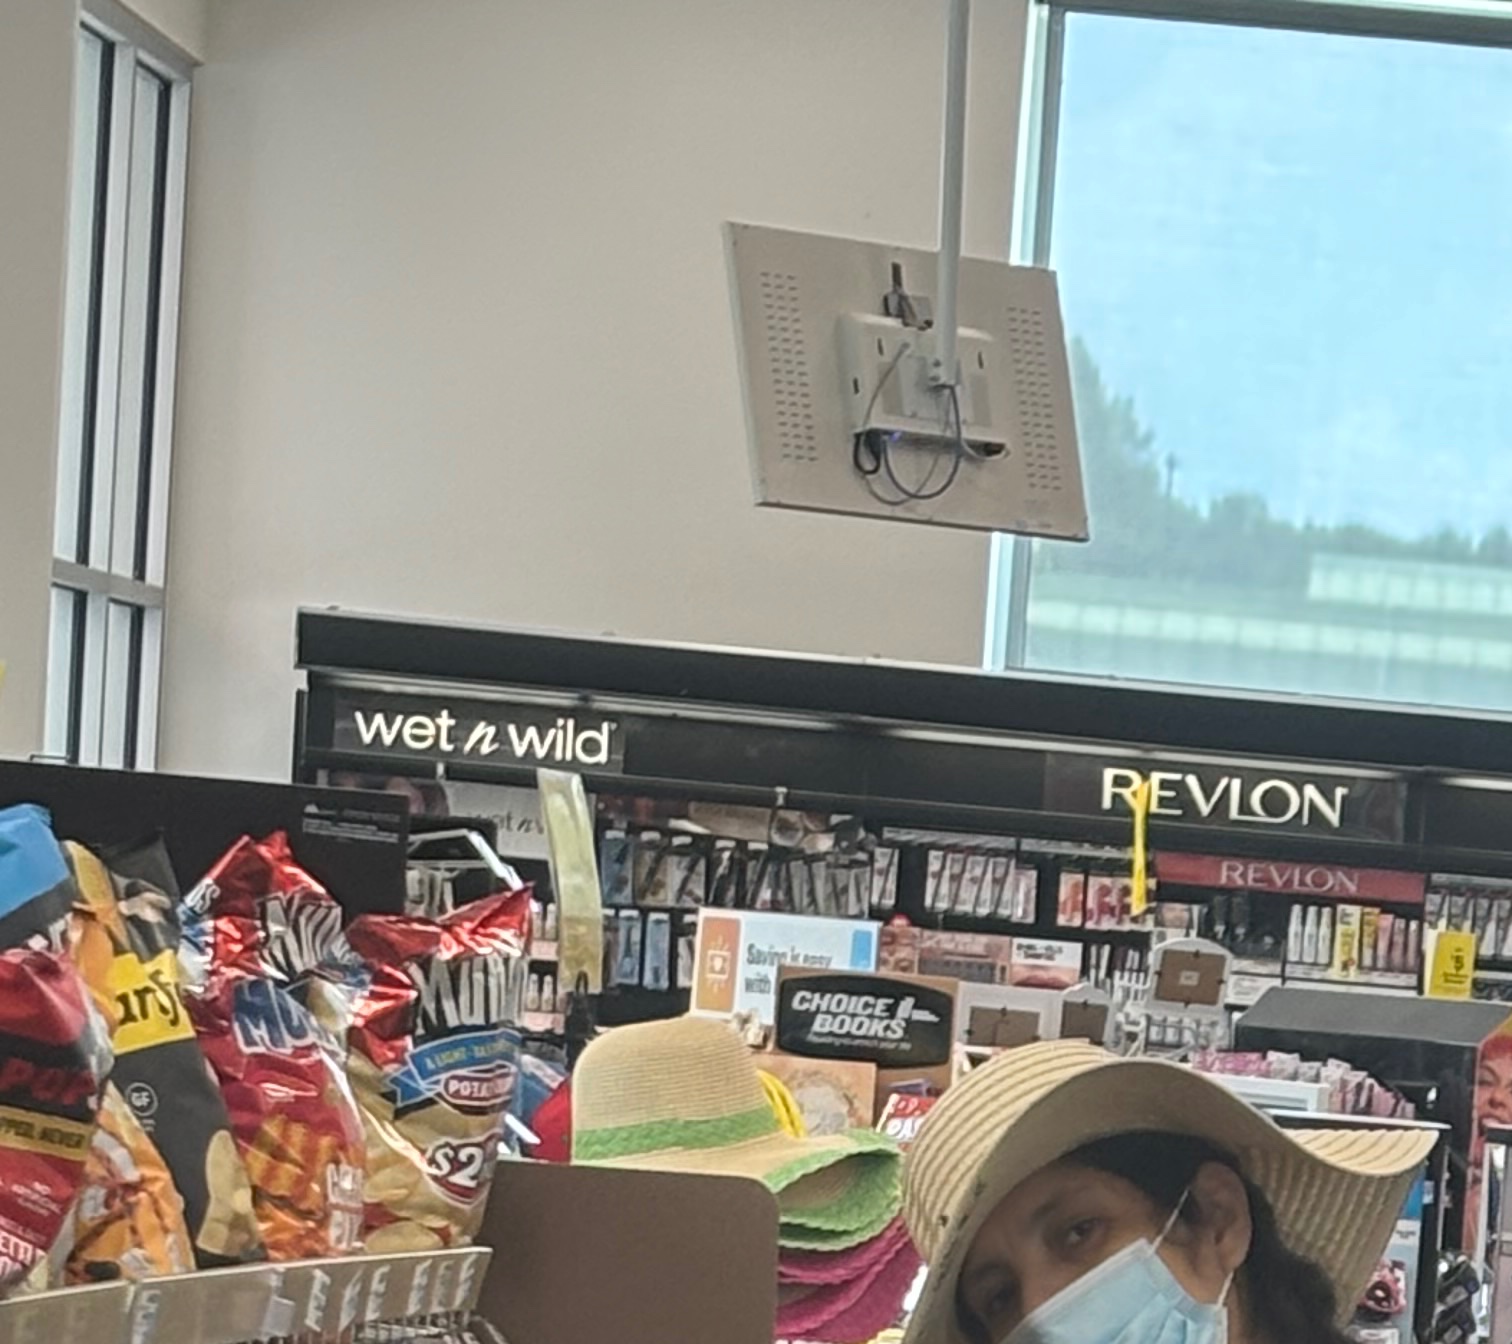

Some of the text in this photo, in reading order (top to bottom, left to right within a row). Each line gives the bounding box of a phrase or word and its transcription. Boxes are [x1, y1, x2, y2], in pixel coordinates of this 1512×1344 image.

[354, 710, 611, 765] wet n wild
[1102, 767, 1349, 828] REVLON
[1220, 861, 1360, 895] REVLON
[791, 990, 895, 1018] CHOICE
[811, 1013, 907, 1040] BOOKS
